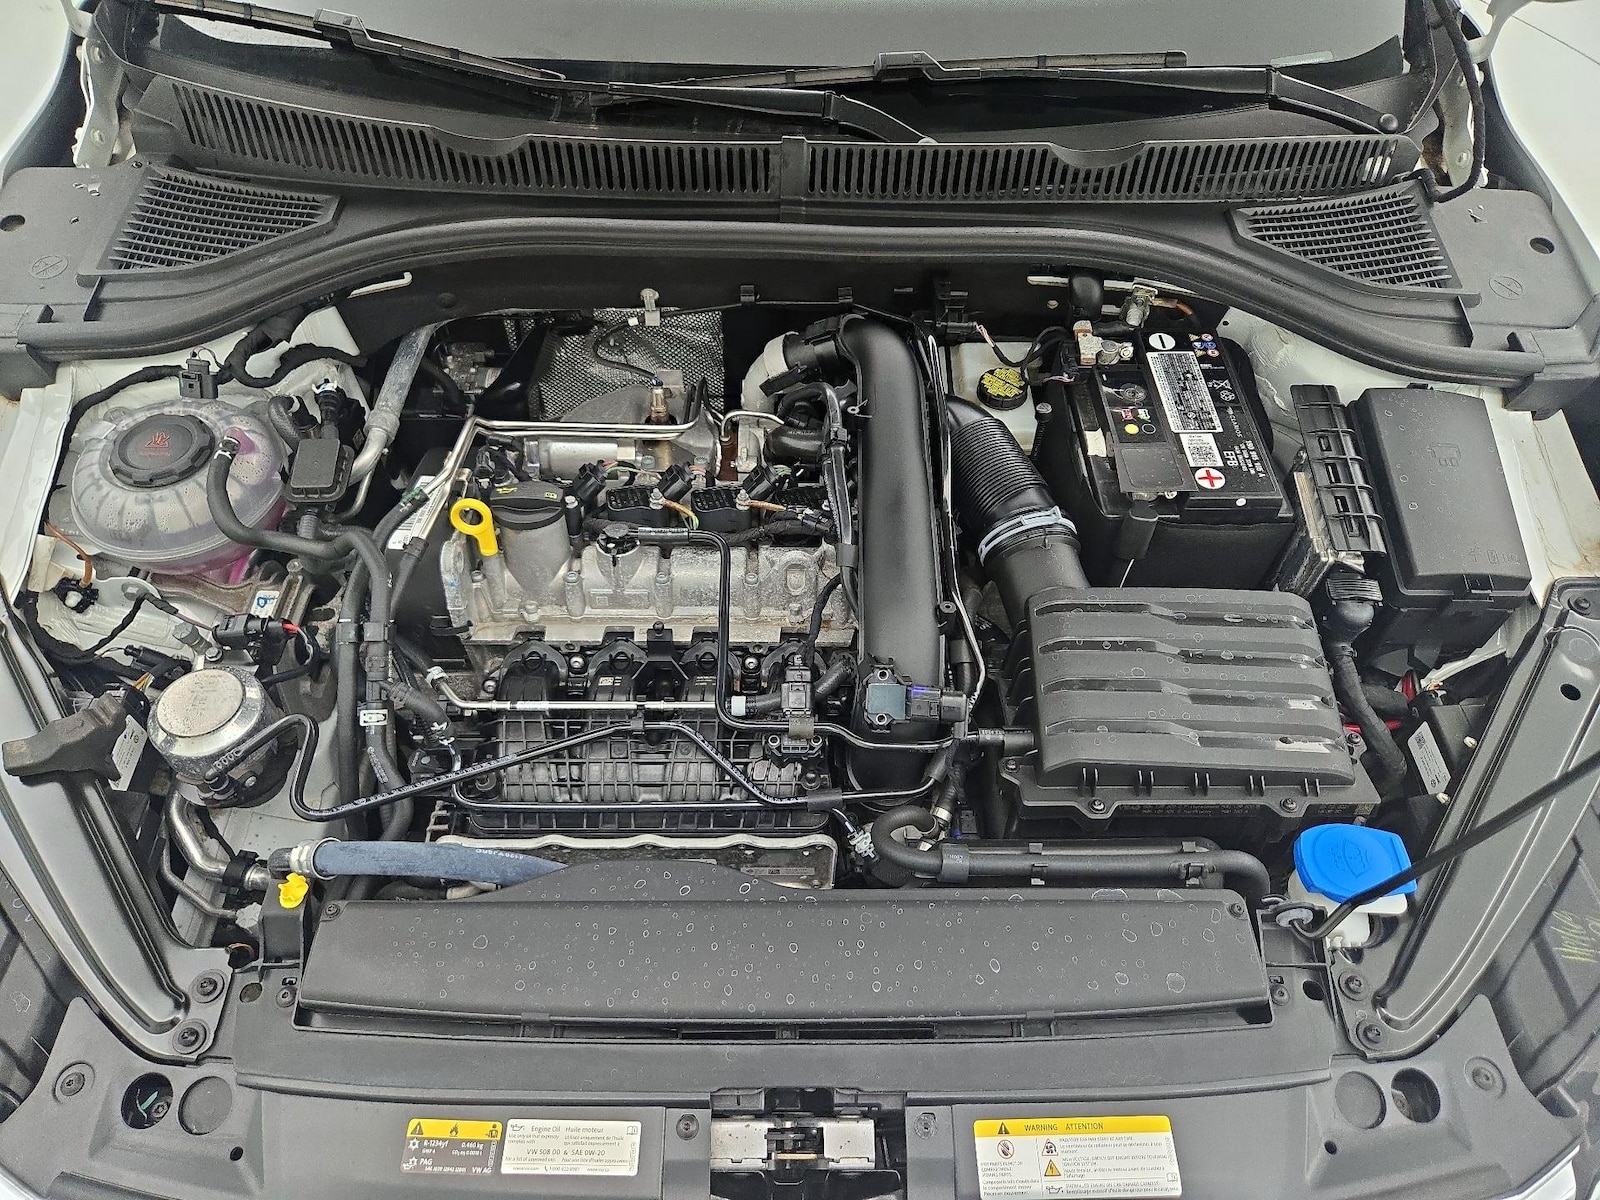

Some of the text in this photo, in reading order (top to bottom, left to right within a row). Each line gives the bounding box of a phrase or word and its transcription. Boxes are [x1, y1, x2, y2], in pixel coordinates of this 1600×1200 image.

[1223, 450, 1238, 465] EFB
[1024, 1122, 1104, 1131] WARNING ATTENTION
[423, 1140, 448, 1149] R-1234yf
